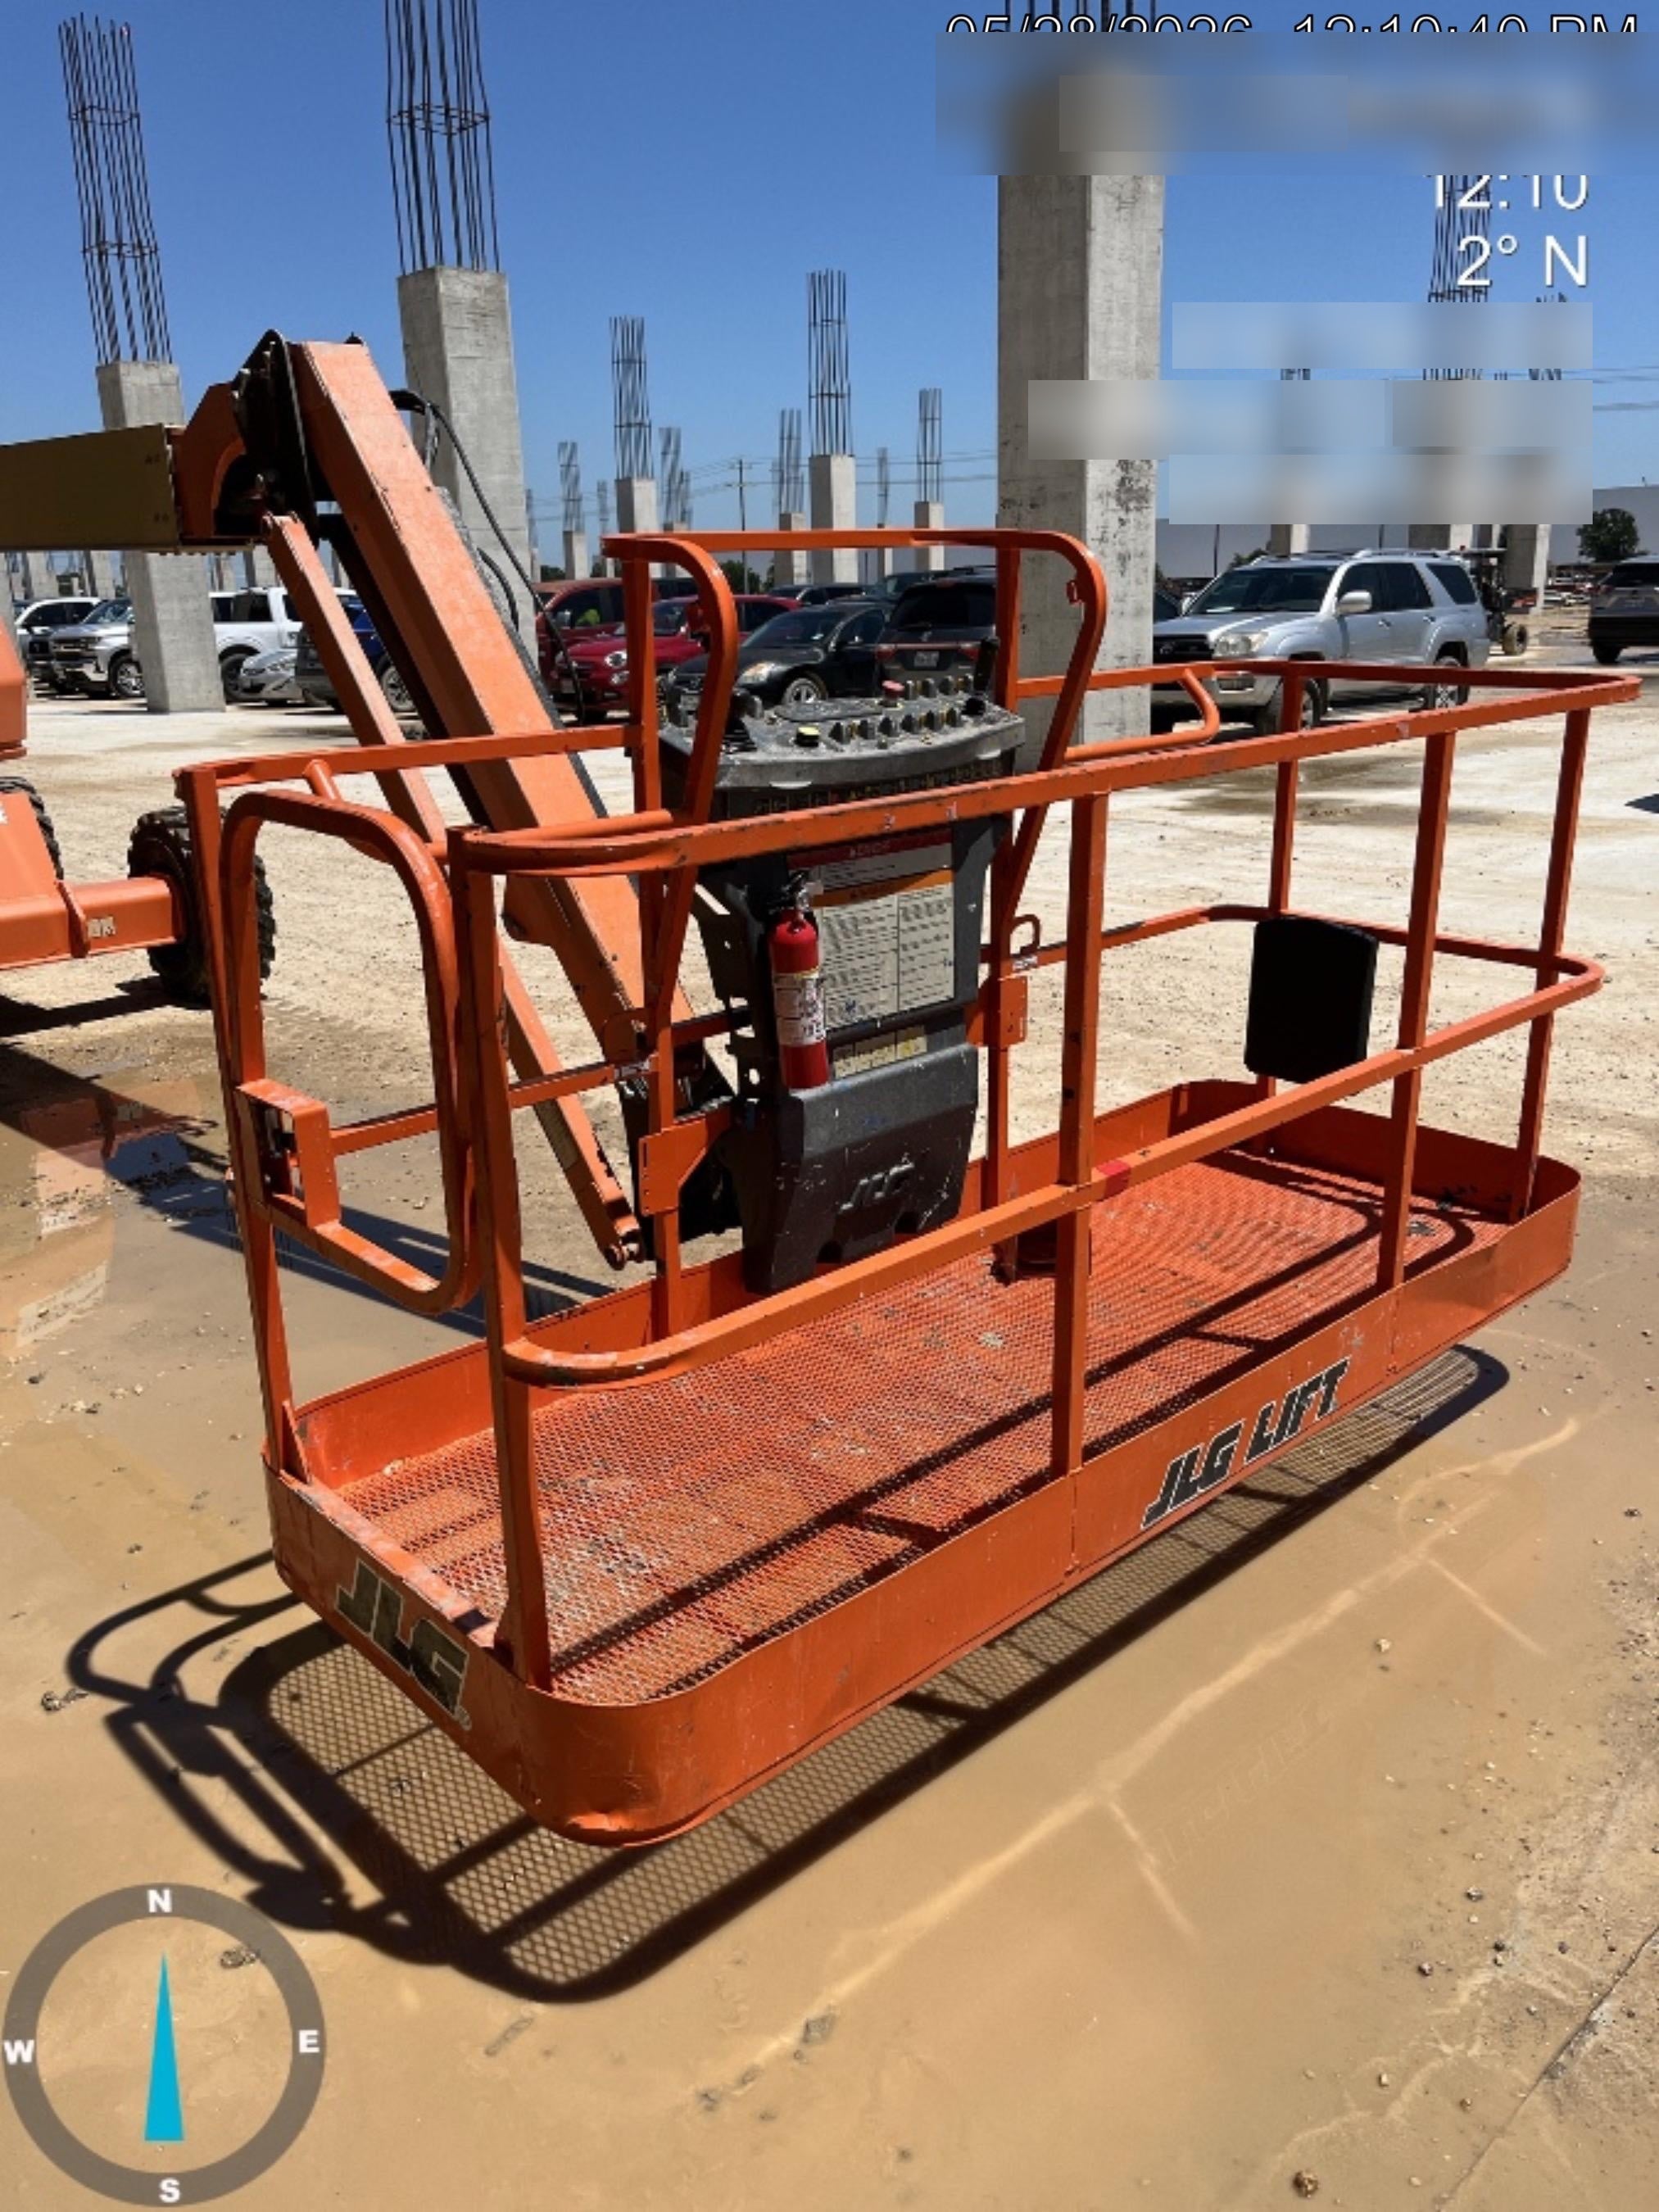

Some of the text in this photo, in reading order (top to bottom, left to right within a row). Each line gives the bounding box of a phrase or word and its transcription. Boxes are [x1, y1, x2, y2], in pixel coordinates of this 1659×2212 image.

[1140, 1354, 1353, 1530] JLG LIFT
[334, 1557, 470, 1720] JLG
